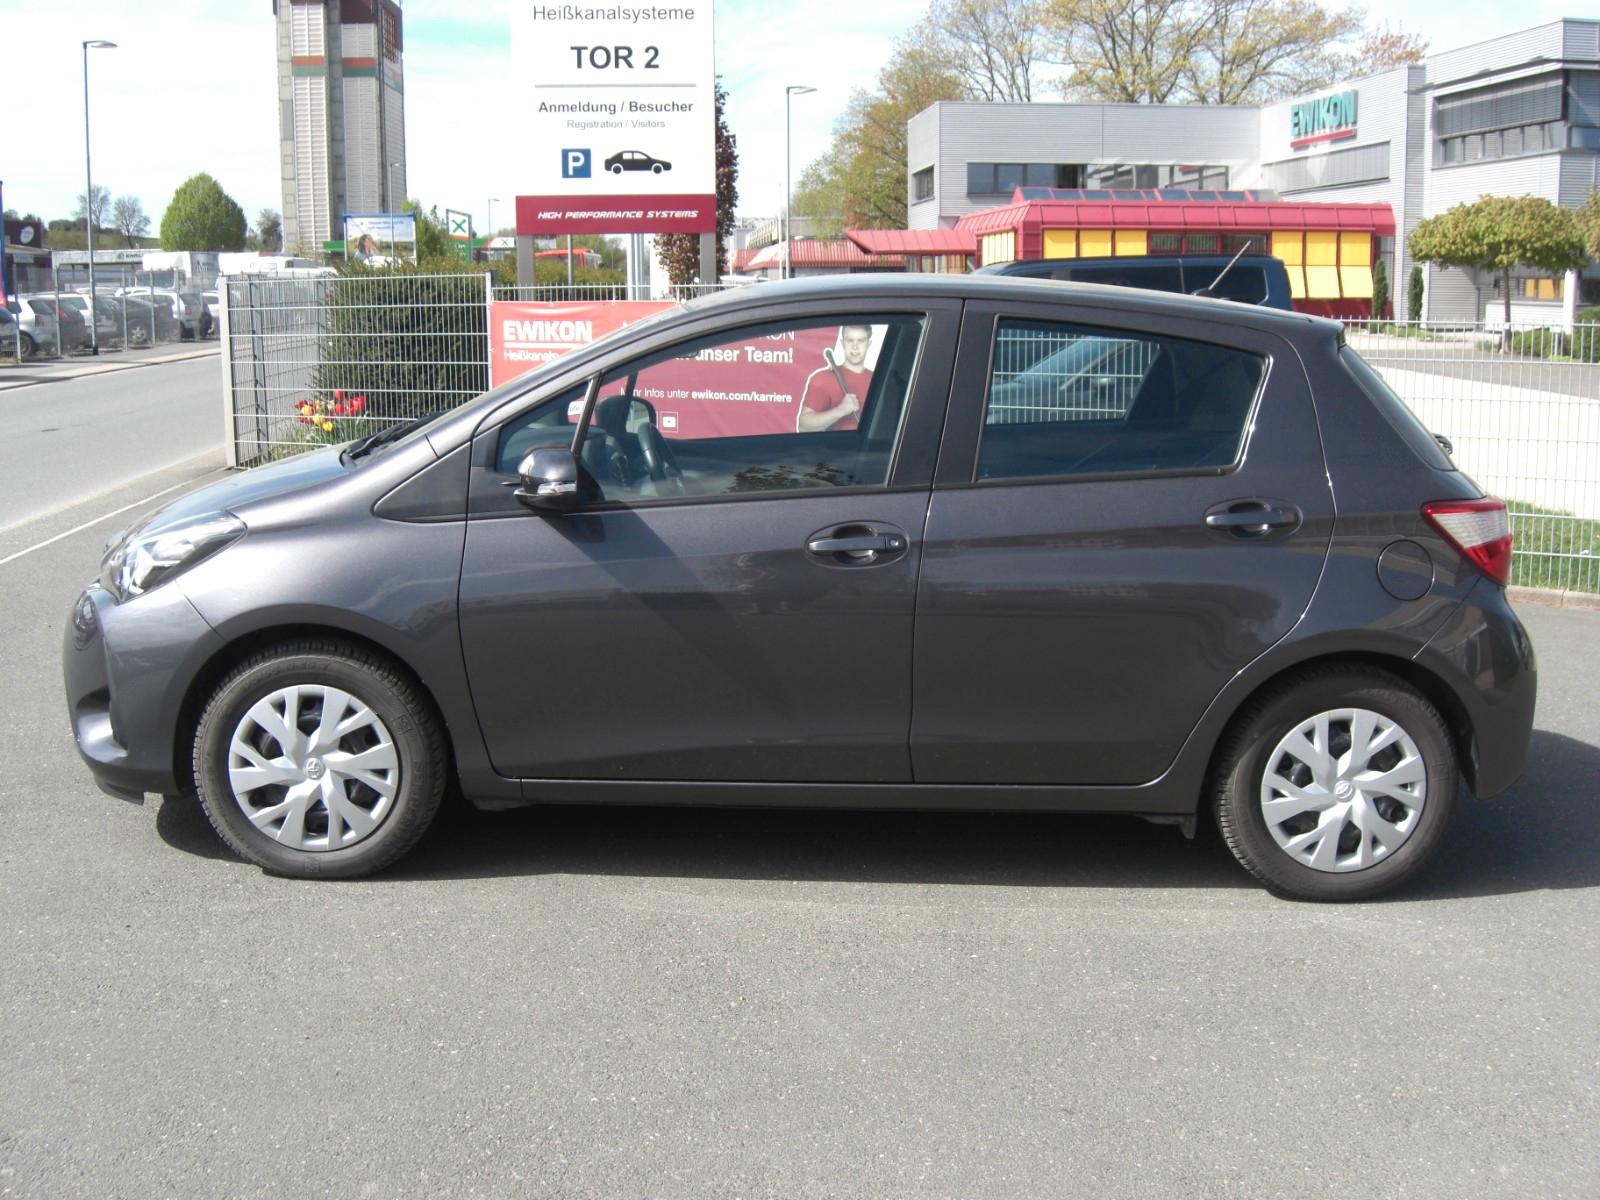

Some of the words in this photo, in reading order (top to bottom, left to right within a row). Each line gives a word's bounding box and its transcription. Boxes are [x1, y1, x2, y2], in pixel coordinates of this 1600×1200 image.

[533, 5, 695, 23] Heißkanalsysteme
[570, 46, 634, 69] TOR
[644, 46, 660, 69] 2
[538, 101, 616, 115] Anmeldung
[629, 101, 693, 112] Besucher
[1290, 89, 1358, 137] EWIKON
[567, 119, 622, 130] Registration
[631, 119, 666, 128] Visitors
[567, 151, 585, 176] P
[537, 211, 562, 220] HIGH
[565, 210, 644, 219] PERFORMANCE
[646, 209, 699, 219] SYSTEMS
[503, 320, 593, 341] EWIKON
[744, 346, 794, 364] Team!
[644, 387, 665, 398] Infos
[667, 388, 689, 399] unter
[691, 389, 793, 403] ewikon.com/karriere
